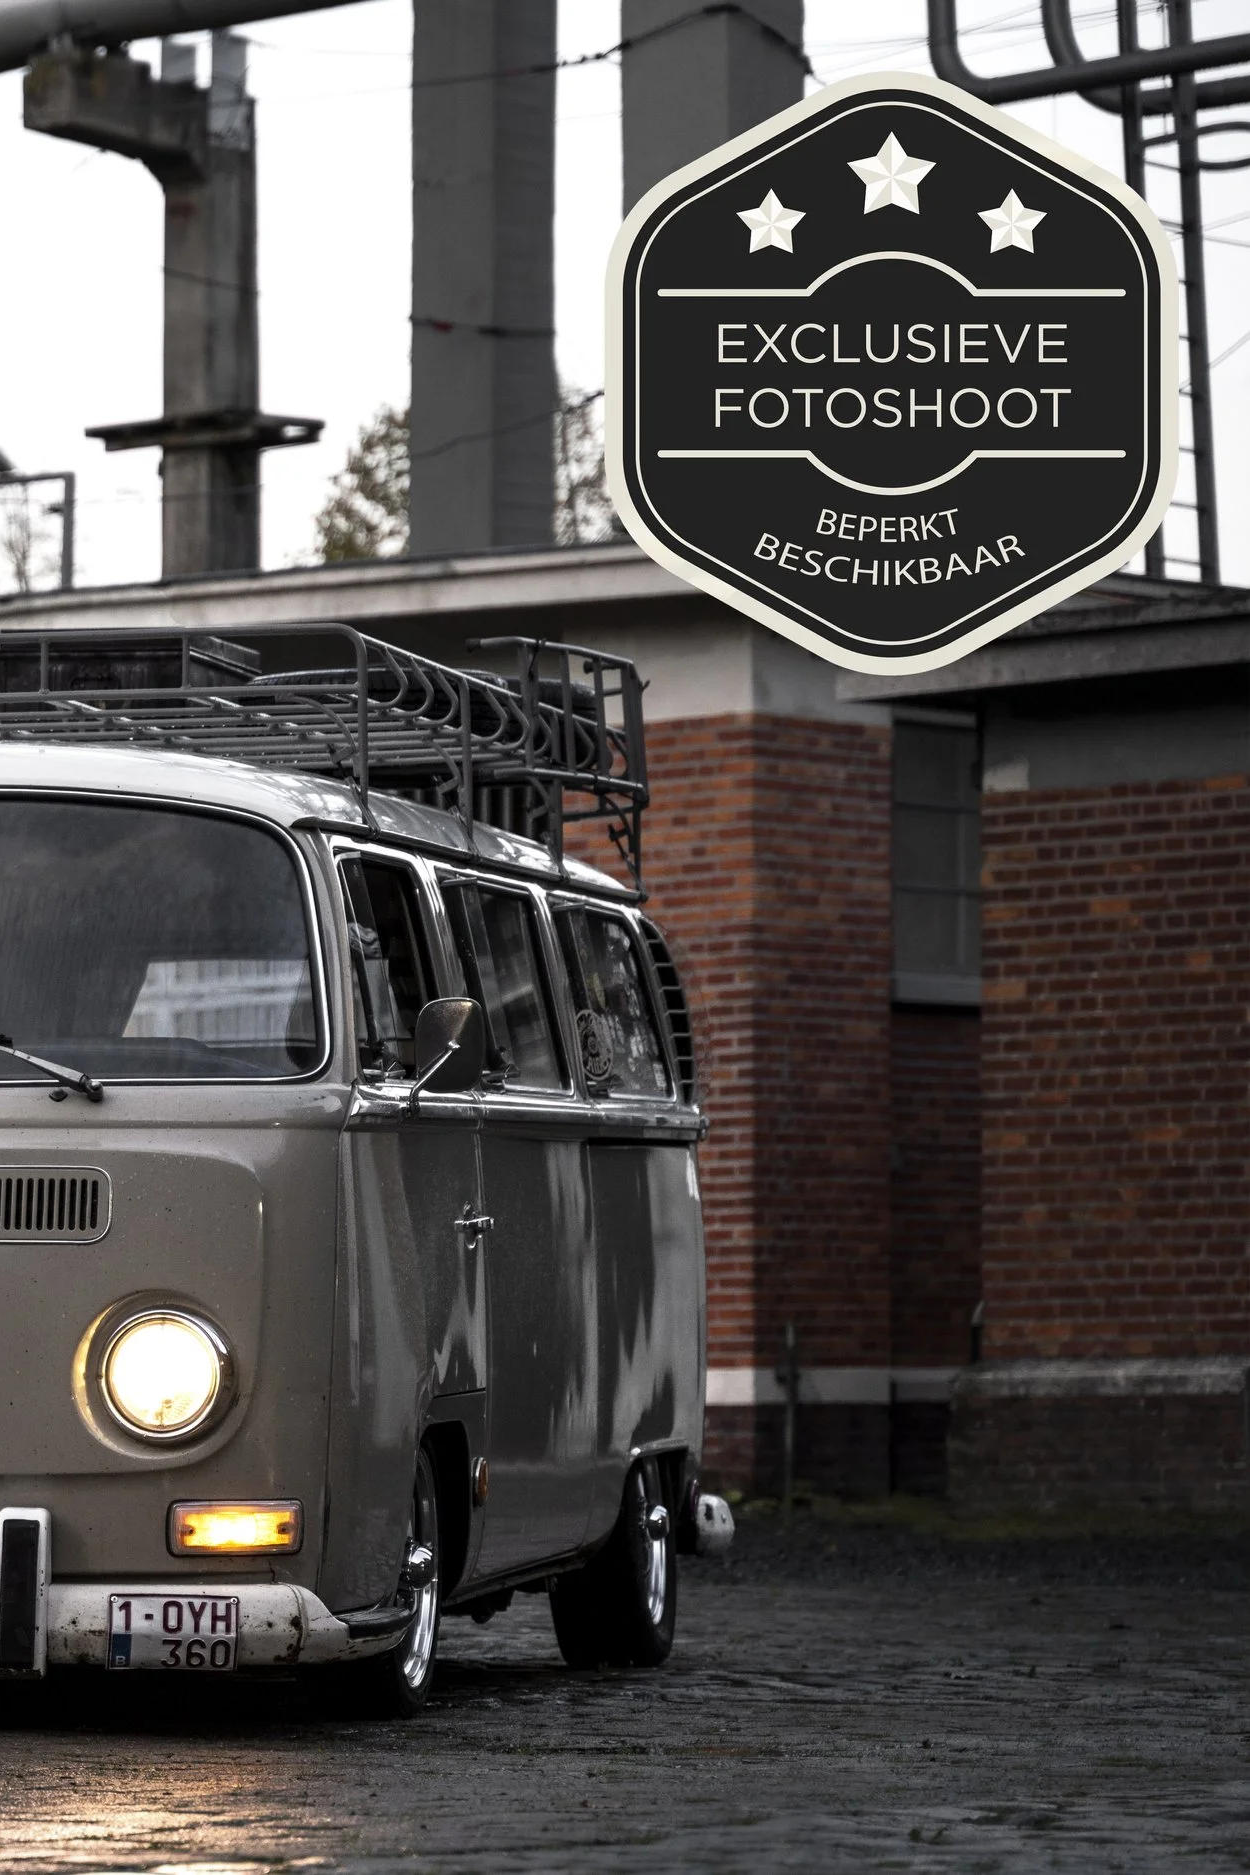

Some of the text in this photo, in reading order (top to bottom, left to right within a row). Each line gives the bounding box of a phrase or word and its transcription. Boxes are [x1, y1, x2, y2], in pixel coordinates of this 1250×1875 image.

[118, 1600, 232, 1635] 1-OYH
[115, 1655, 126, 1667] B
[161, 1638, 232, 1668] 360
